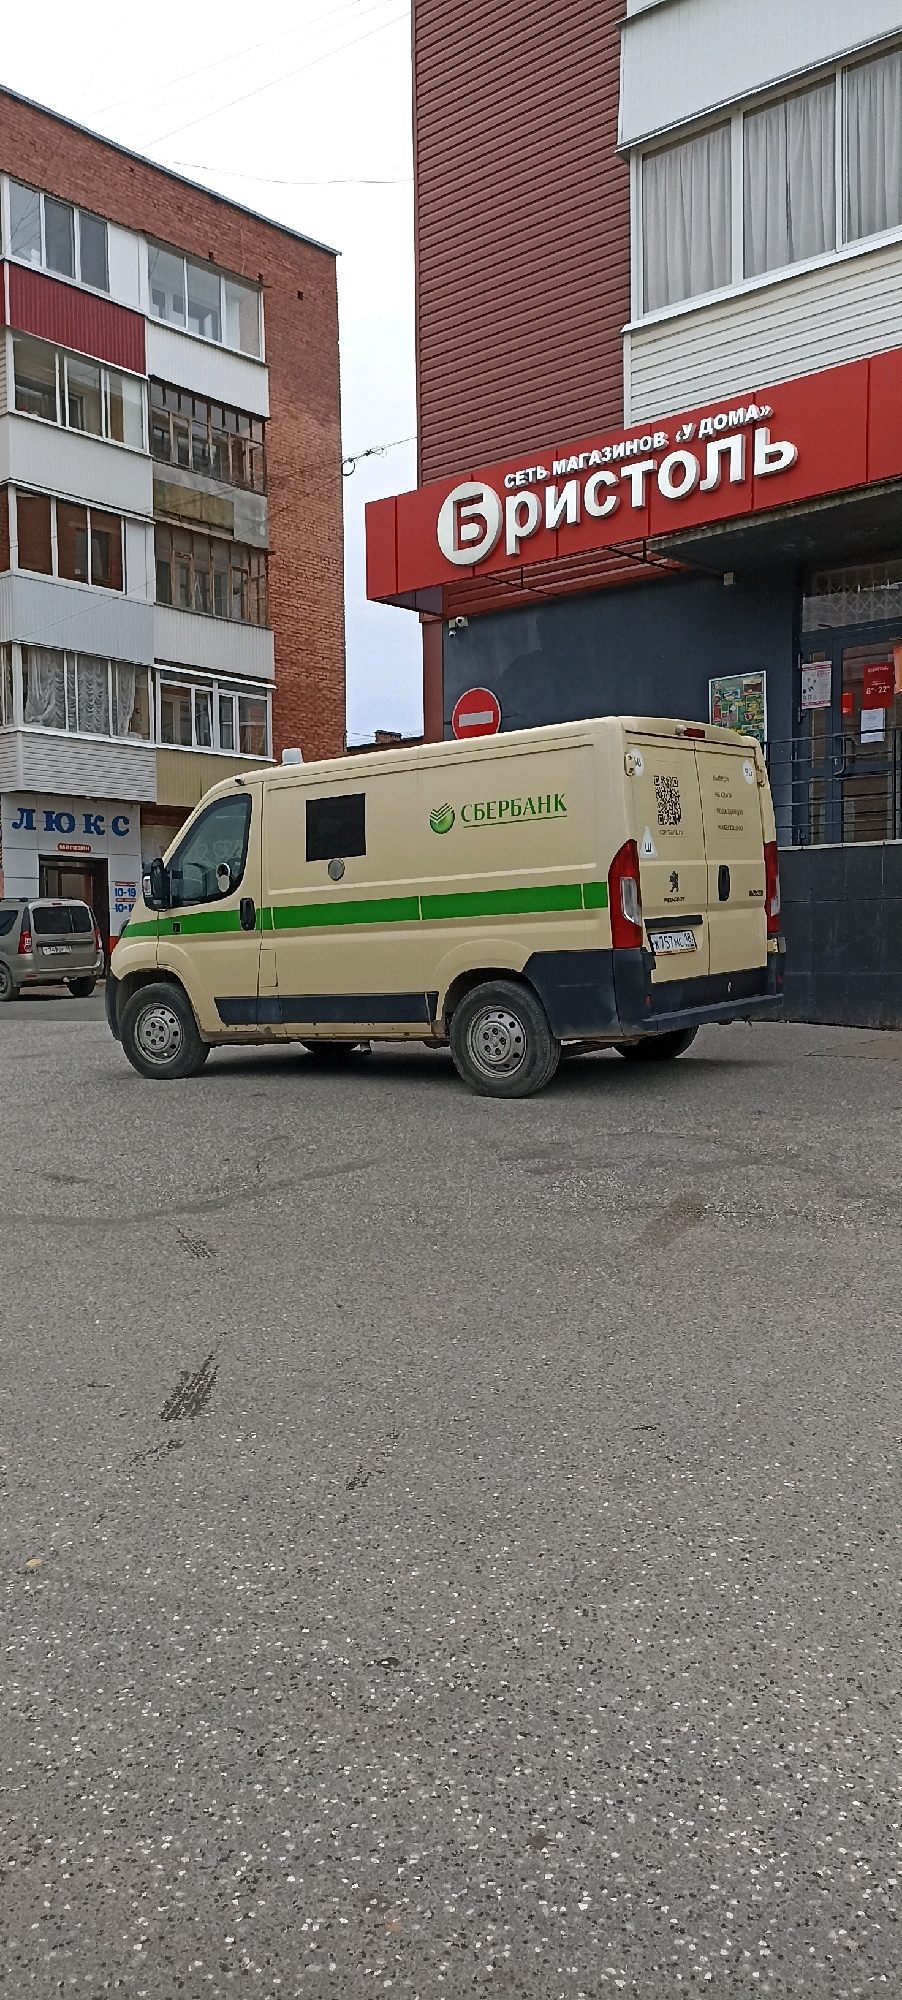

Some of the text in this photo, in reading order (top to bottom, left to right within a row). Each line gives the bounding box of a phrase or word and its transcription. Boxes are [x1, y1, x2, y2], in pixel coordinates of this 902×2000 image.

[504, 466, 549, 490] СЕТЬ
[552, 430, 668, 477] МАГАЗИНОВ
[698, 403, 774, 439] ДОМА»
[437, 427, 798, 565] Бристоль
[12, 807, 130, 836] ЛЮКС
[460, 793, 567, 823] СБЕРБАНК
[644, 842, 652, 853] Ш
[114, 887, 137, 897] 10-19
